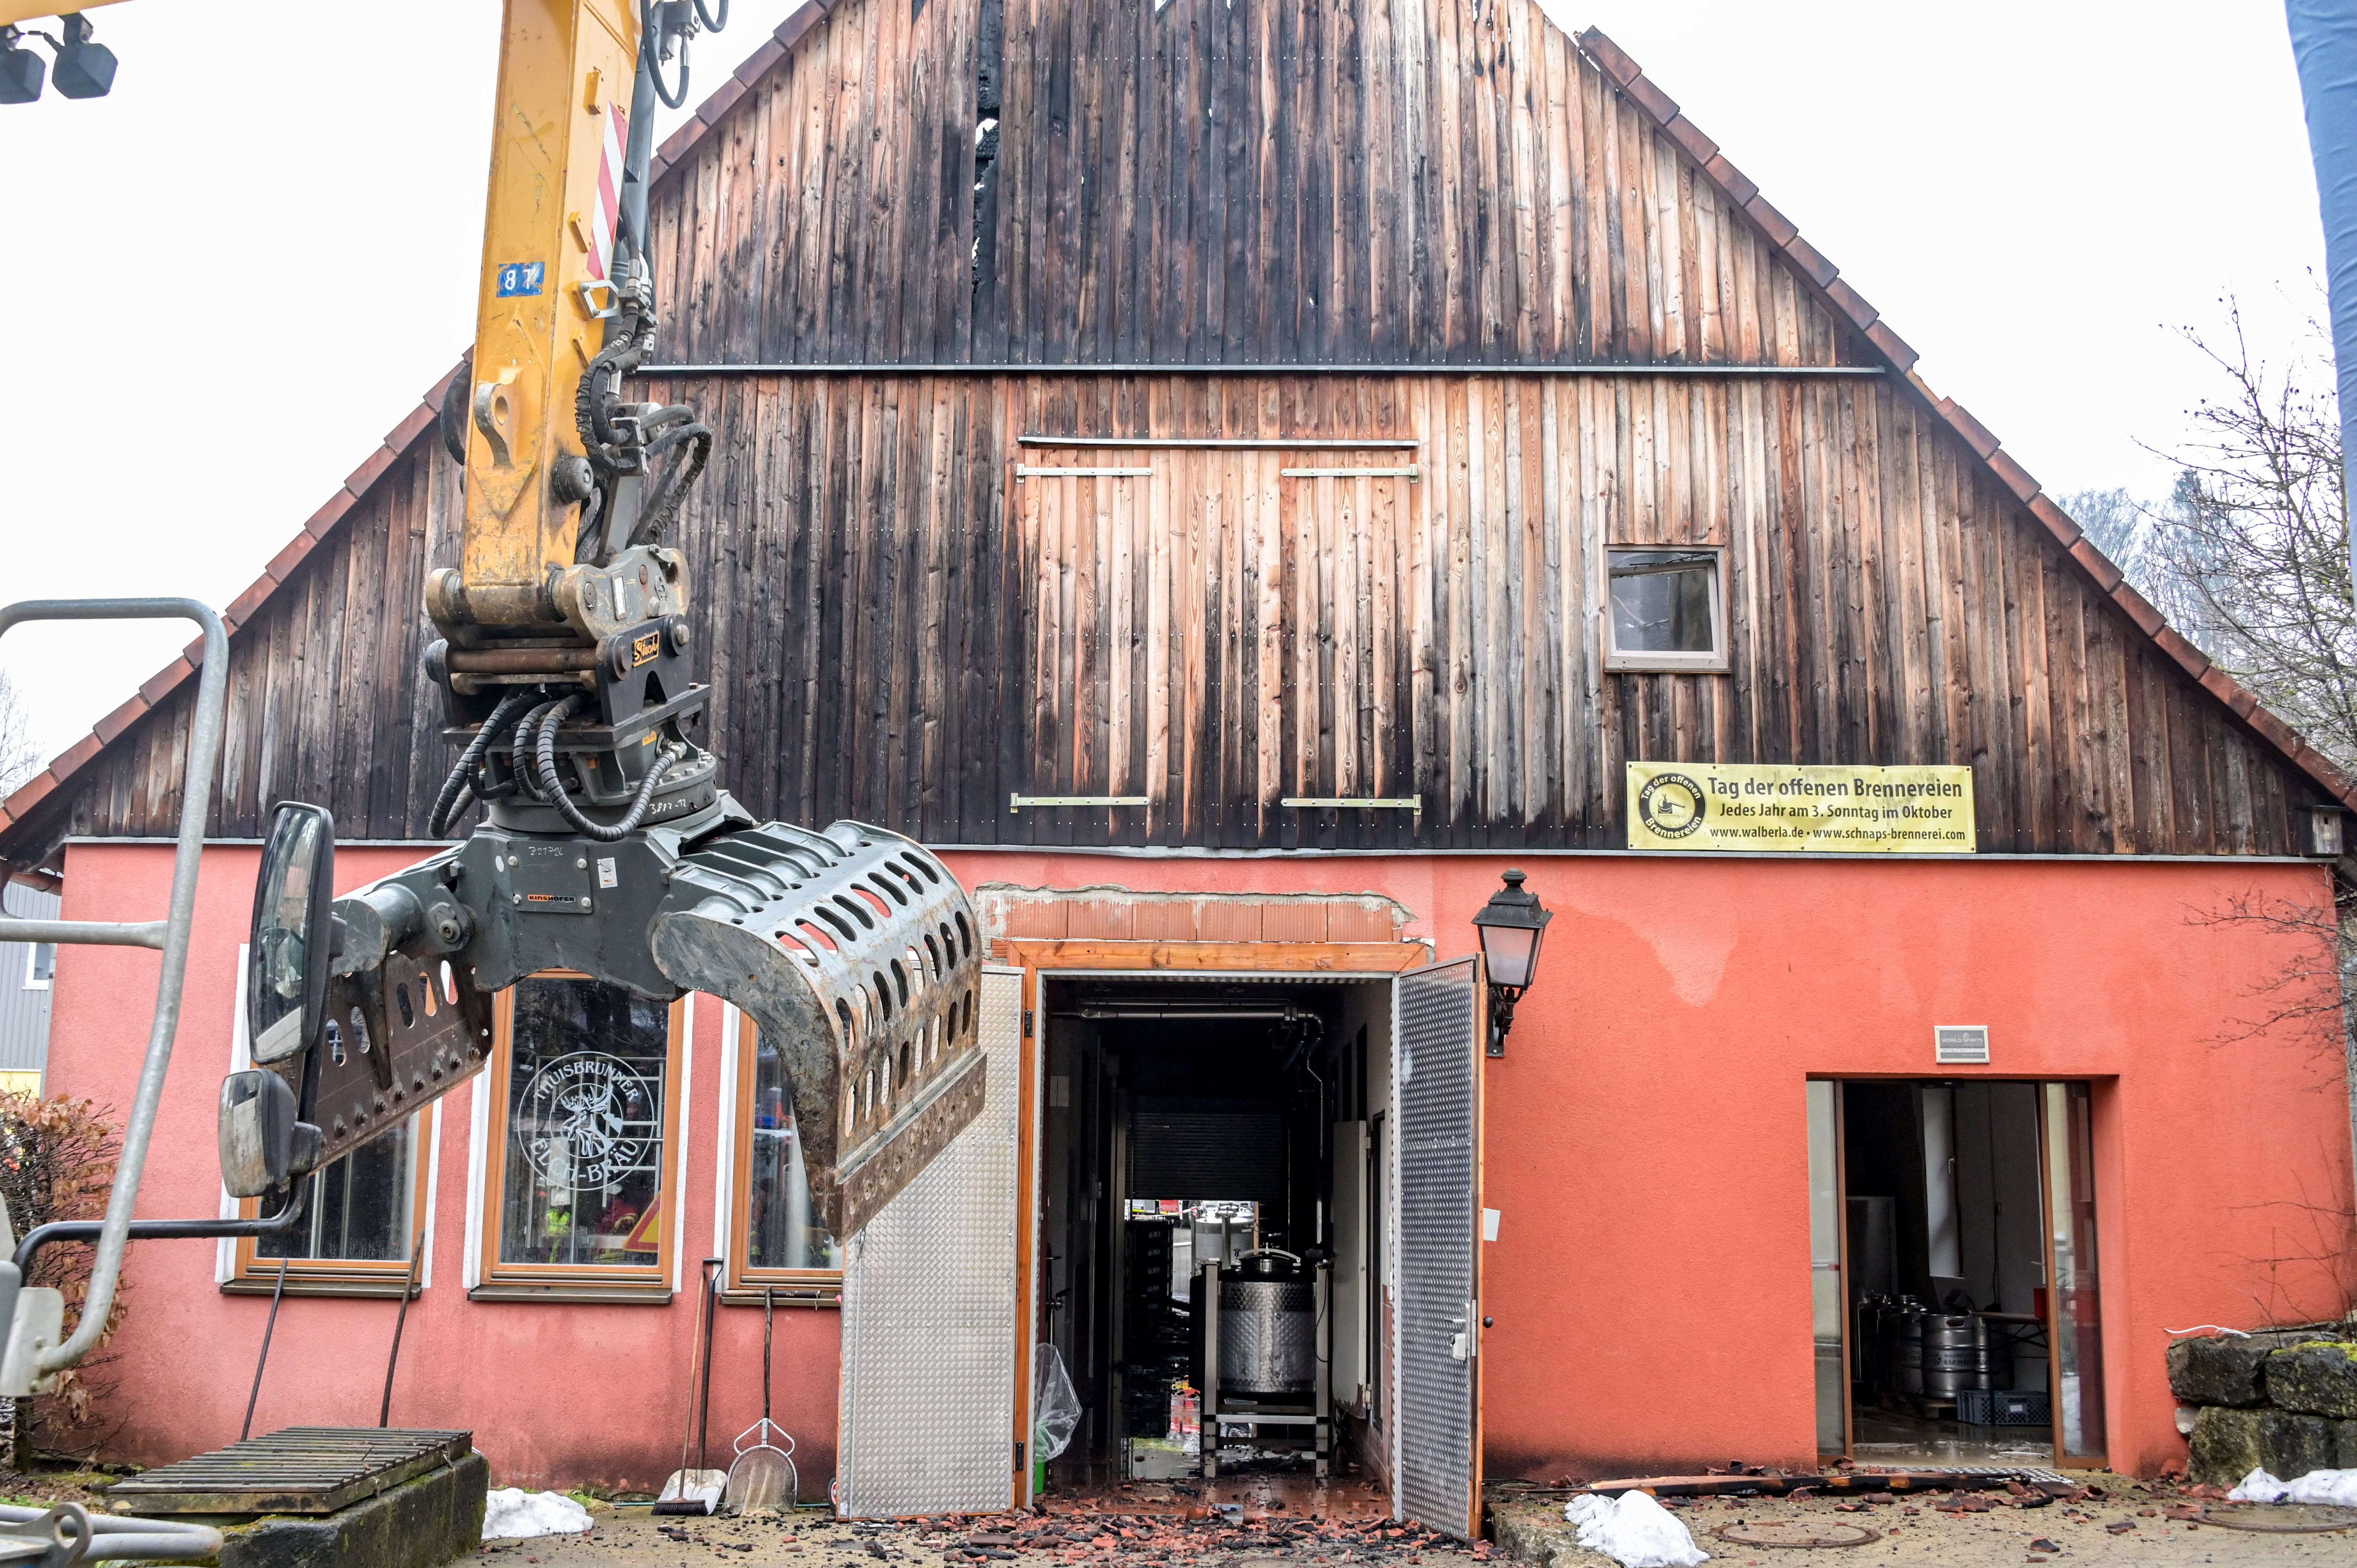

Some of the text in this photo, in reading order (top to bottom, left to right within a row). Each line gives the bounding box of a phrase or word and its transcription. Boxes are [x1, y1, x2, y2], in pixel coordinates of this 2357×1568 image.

[1641, 776, 1701, 799] Tag der offenen
[1708, 777, 1962, 799] Tag der offenen Brennereien
[1720, 803, 1952, 822] Jedes Jahr am 3. Sonntag im Oktober
[1645, 816, 1702, 838] Brennereien
[1710, 826, 1965, 842] www.walberla.de www.schnaps-brennerei.com
[533, 1061, 639, 1101] THUISBRUNNER
[530, 1138, 639, 1183] ELCH-BRÄU
